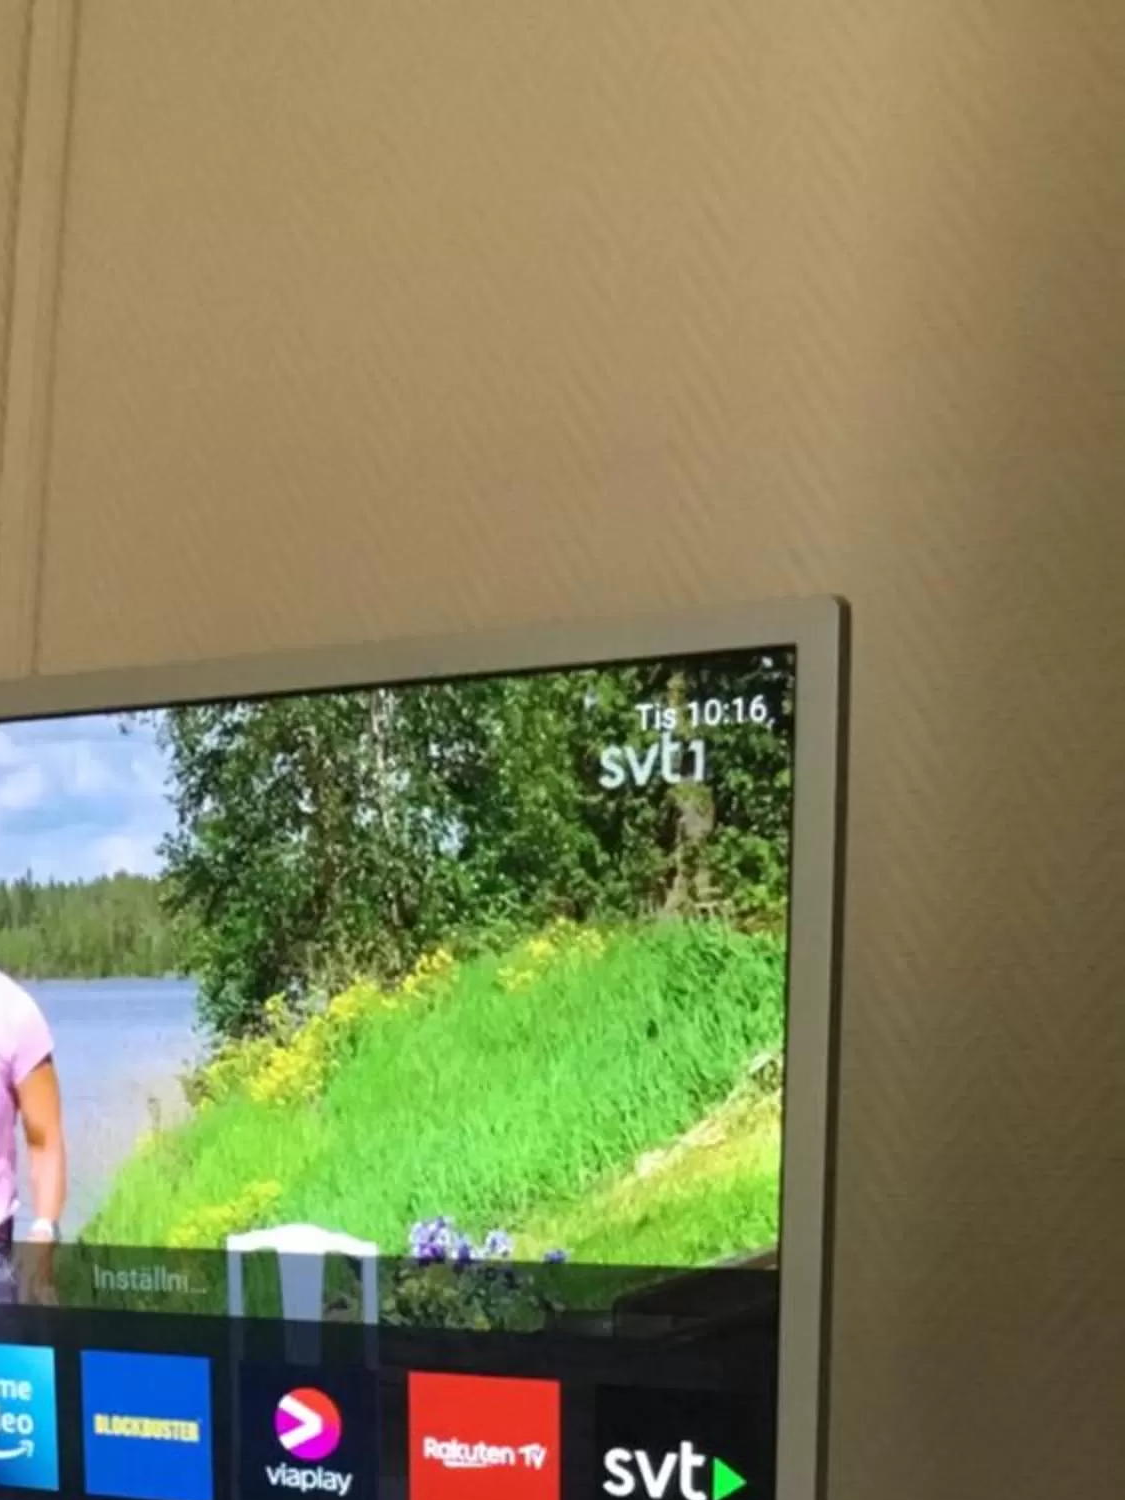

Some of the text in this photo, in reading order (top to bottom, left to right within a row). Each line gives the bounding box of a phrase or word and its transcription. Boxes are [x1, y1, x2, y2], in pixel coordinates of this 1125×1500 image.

[635, 694, 767, 731] Tis 10:16
[598, 729, 705, 789] svt1
[422, 1434, 516, 1469] Rakuten
[265, 1463, 352, 1497] viaplay
